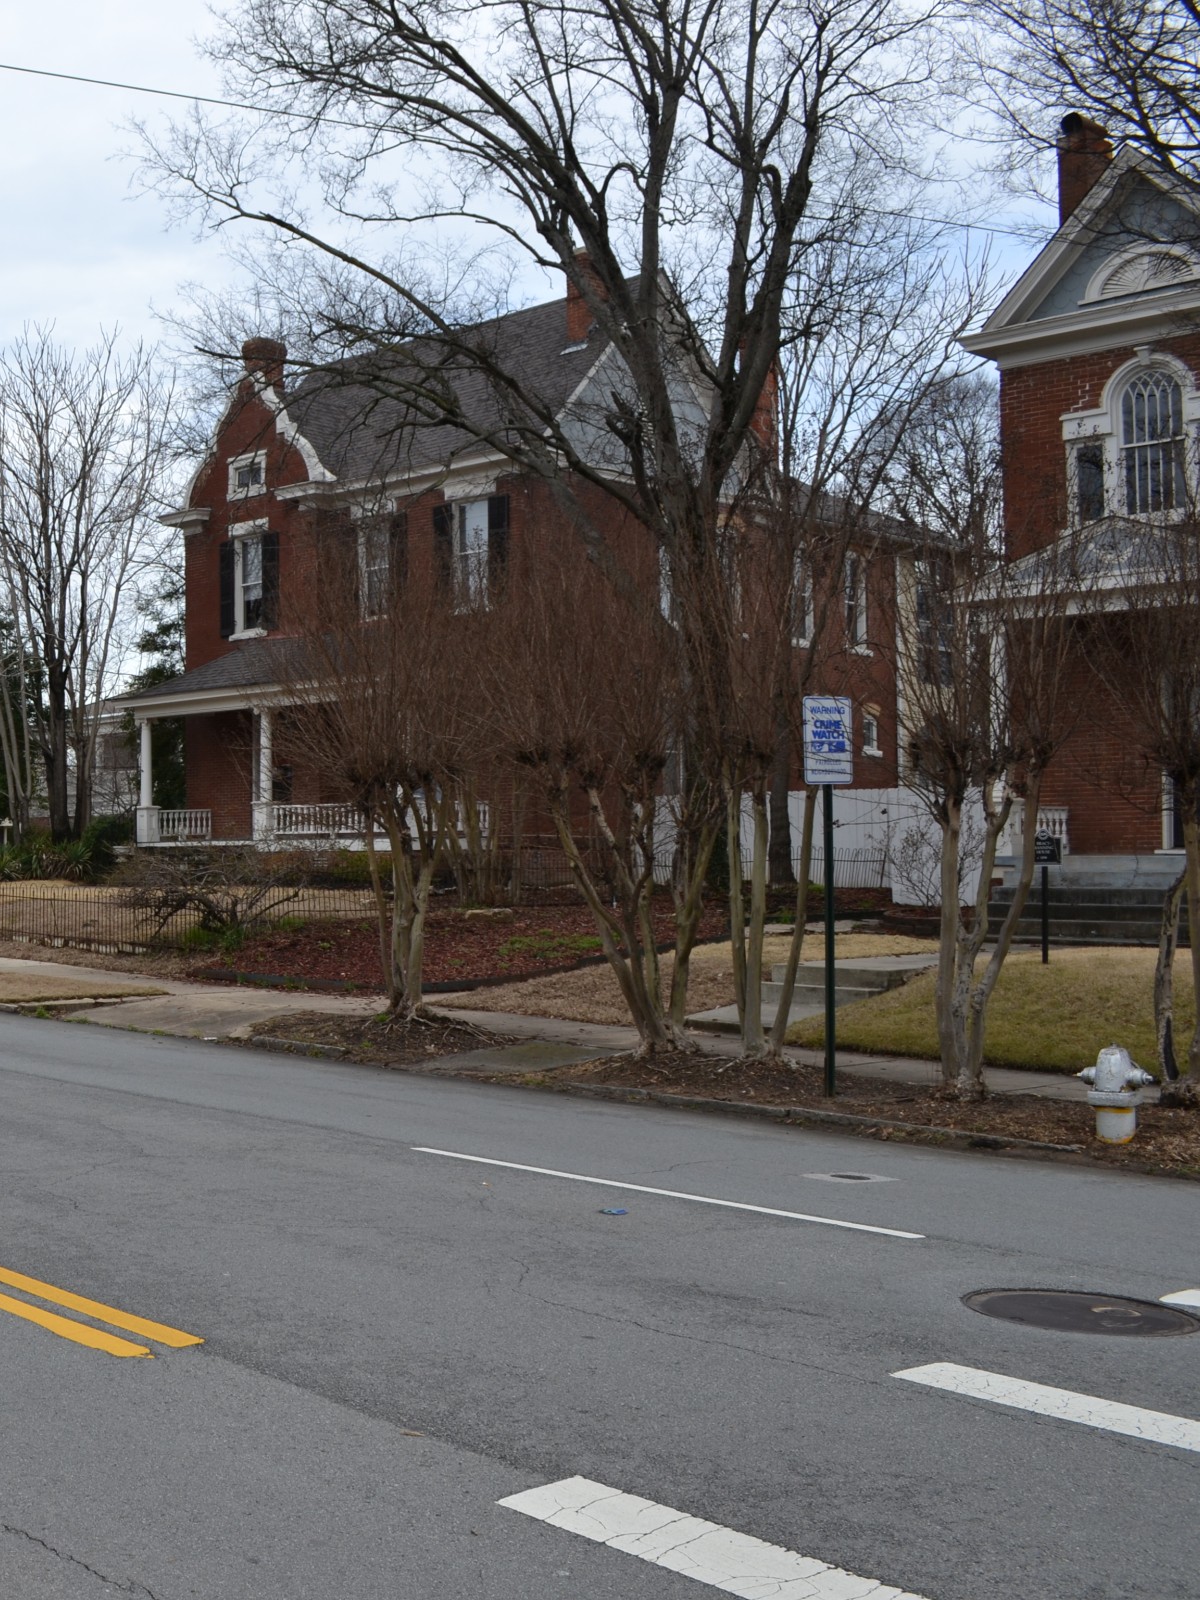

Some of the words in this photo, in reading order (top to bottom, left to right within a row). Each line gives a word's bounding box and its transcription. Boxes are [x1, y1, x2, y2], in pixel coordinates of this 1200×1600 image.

[810, 706, 845, 714] WARNING
[813, 720, 843, 729] CRIME
[811, 730, 845, 739] WATCH
